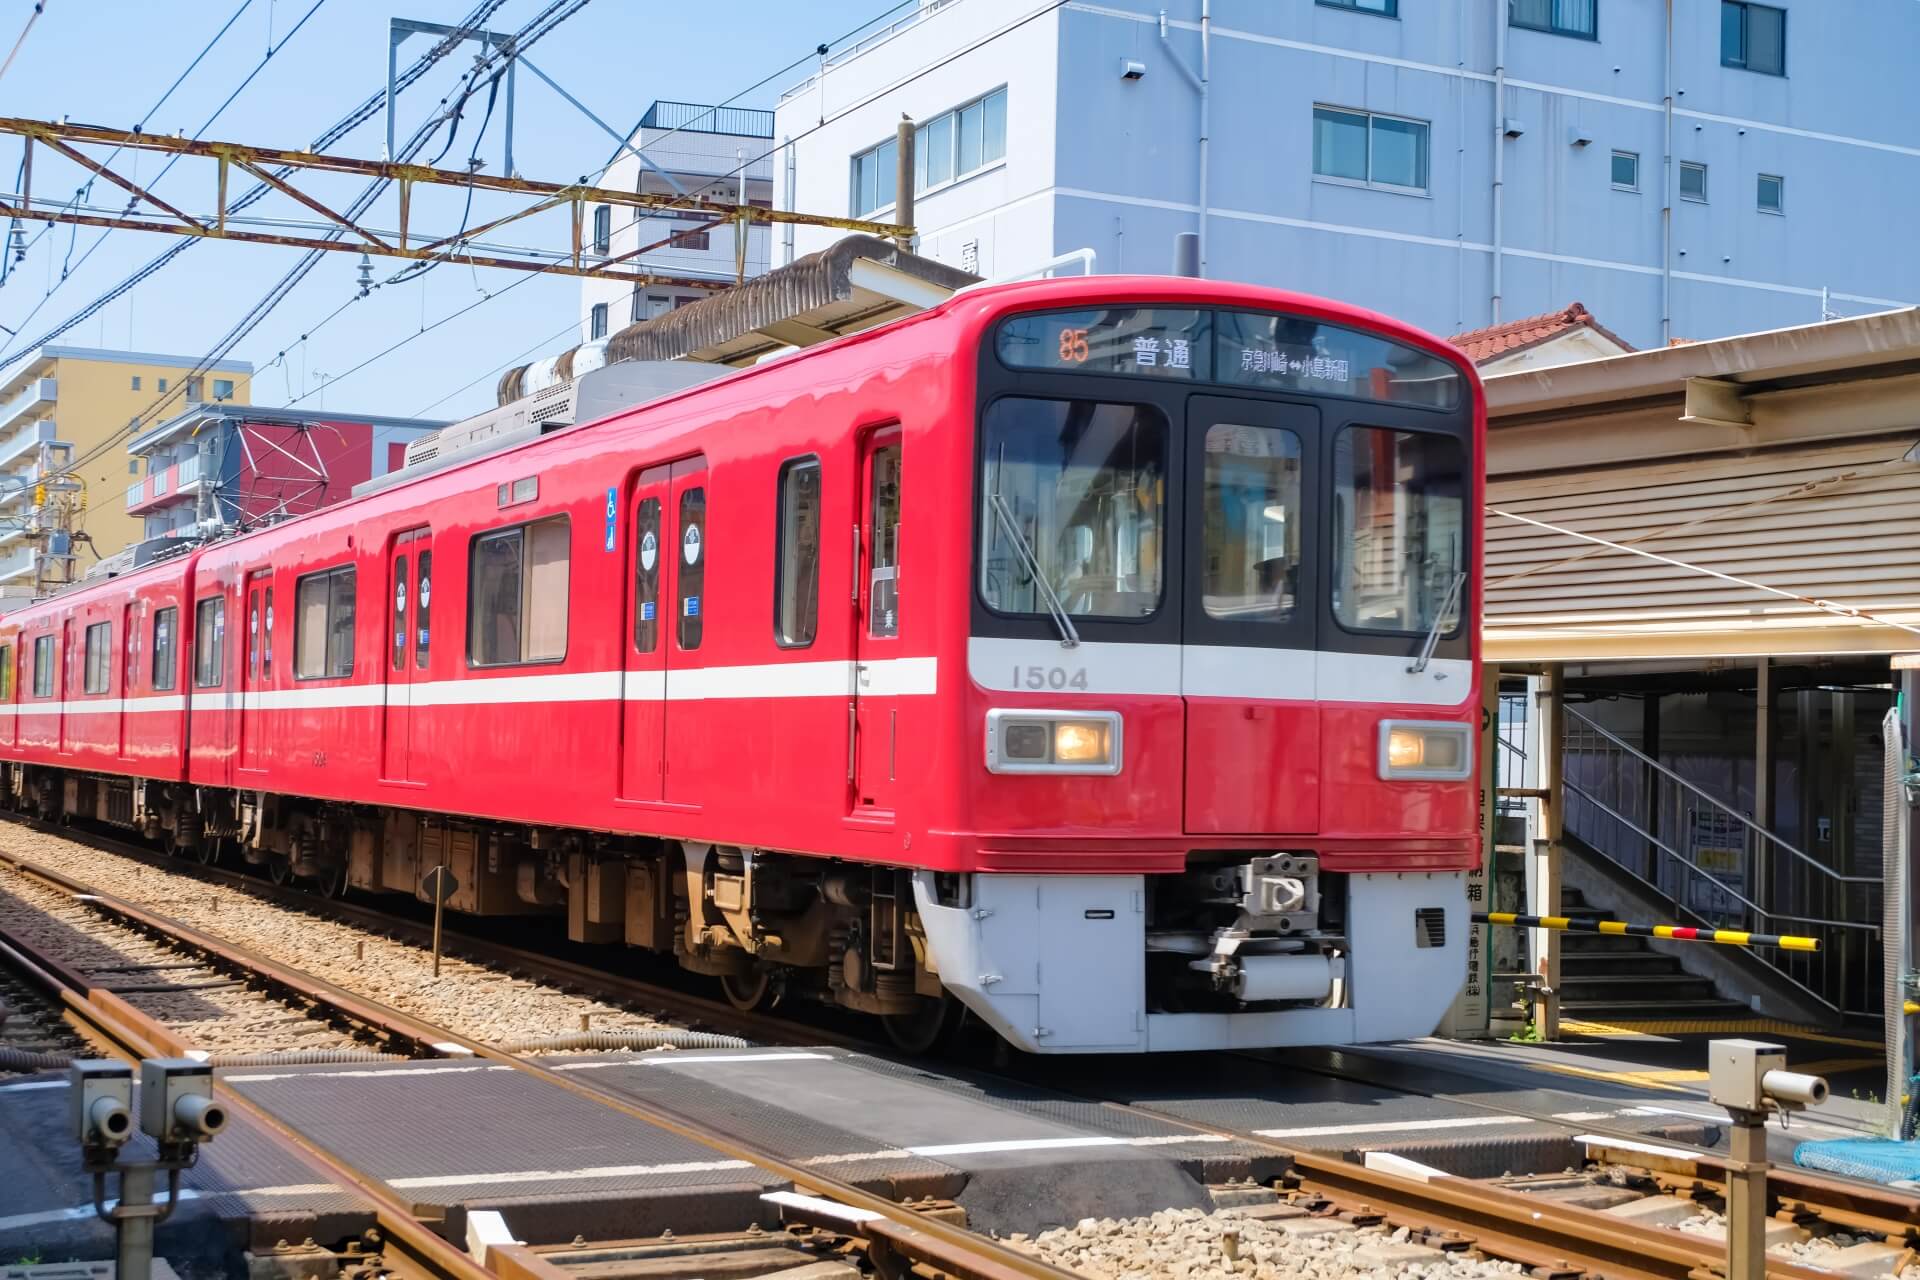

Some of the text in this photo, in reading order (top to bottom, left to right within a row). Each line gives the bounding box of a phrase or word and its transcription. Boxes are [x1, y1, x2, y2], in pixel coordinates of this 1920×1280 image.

[1059, 328, 1088, 362] 85
[1133, 336, 1190, 369] 普通
[1302, 354, 1349, 382] 小島新田
[1013, 665, 1088, 690] 1504
